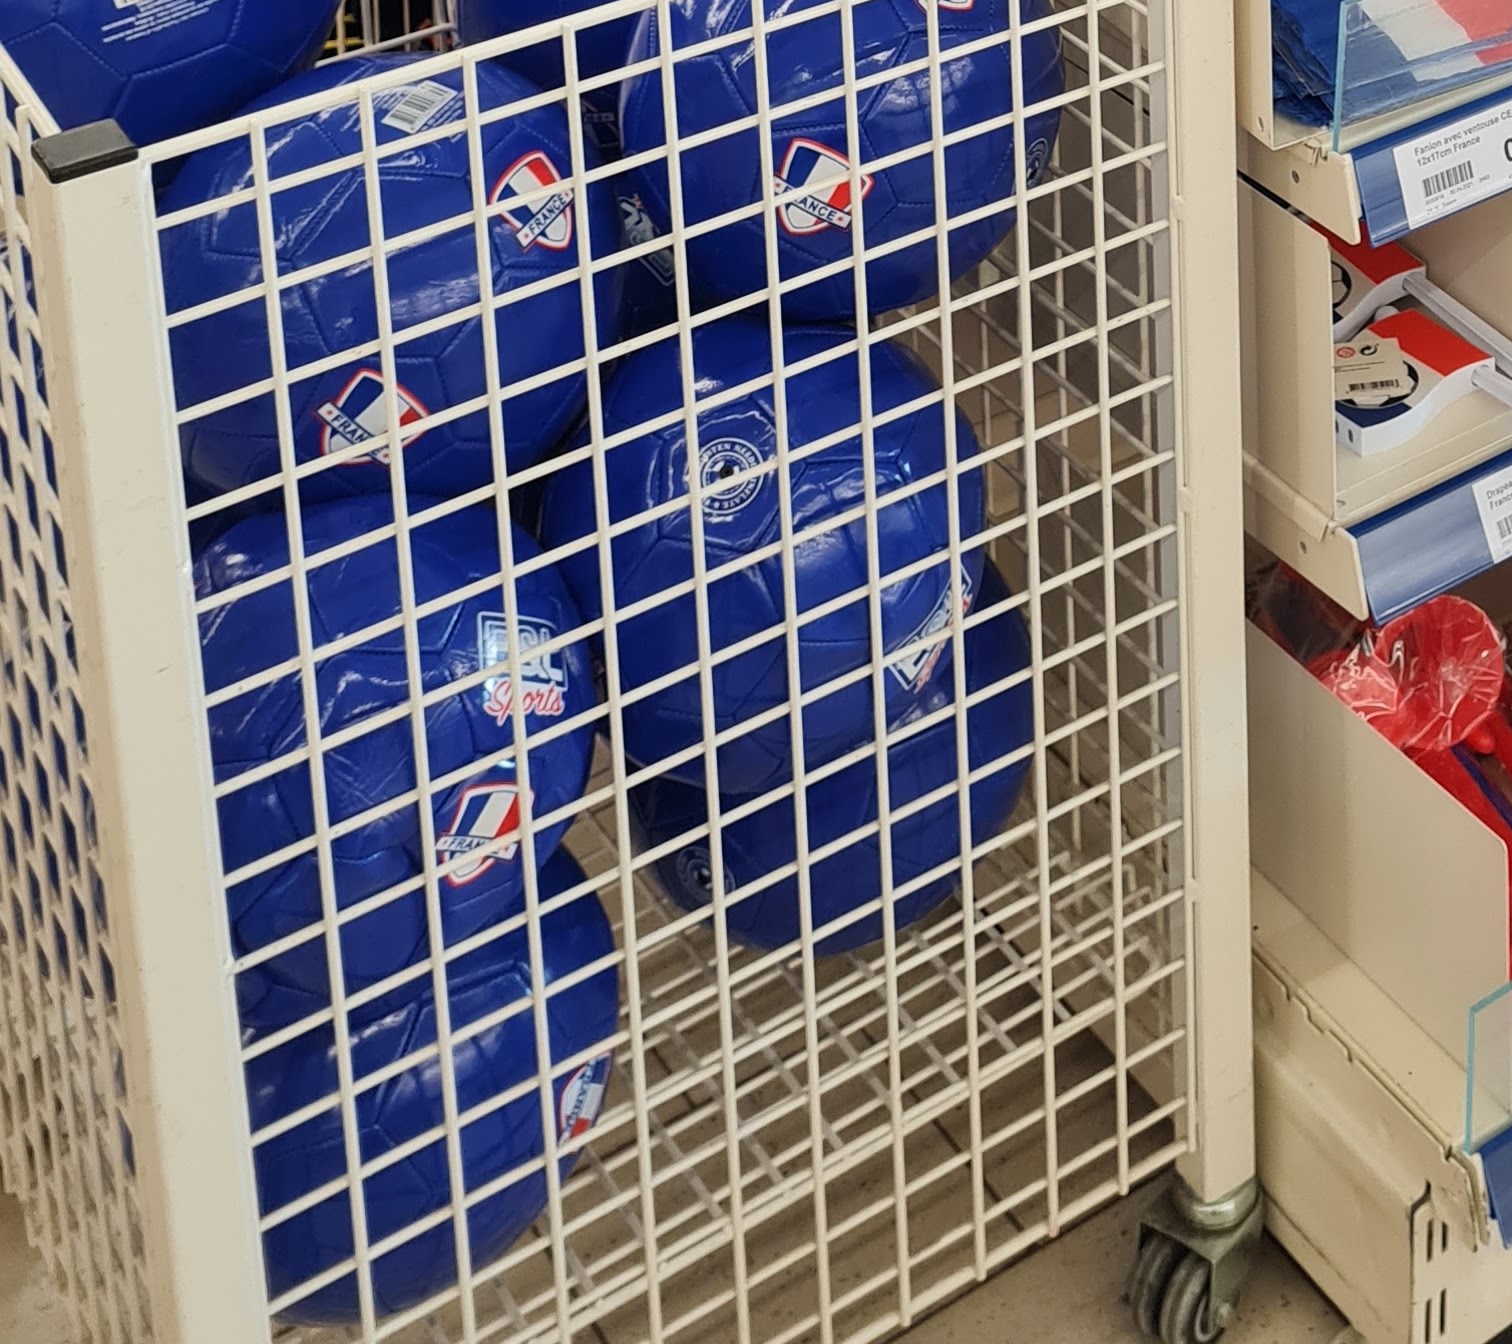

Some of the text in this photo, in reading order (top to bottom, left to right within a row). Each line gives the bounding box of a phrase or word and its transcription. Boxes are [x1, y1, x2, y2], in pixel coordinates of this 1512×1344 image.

[1414, 109, 1512, 157] Fanion avec ventouse CE
[1417, 135, 1480, 167] 12x17cm France
[527, 194, 568, 237] FRANCE
